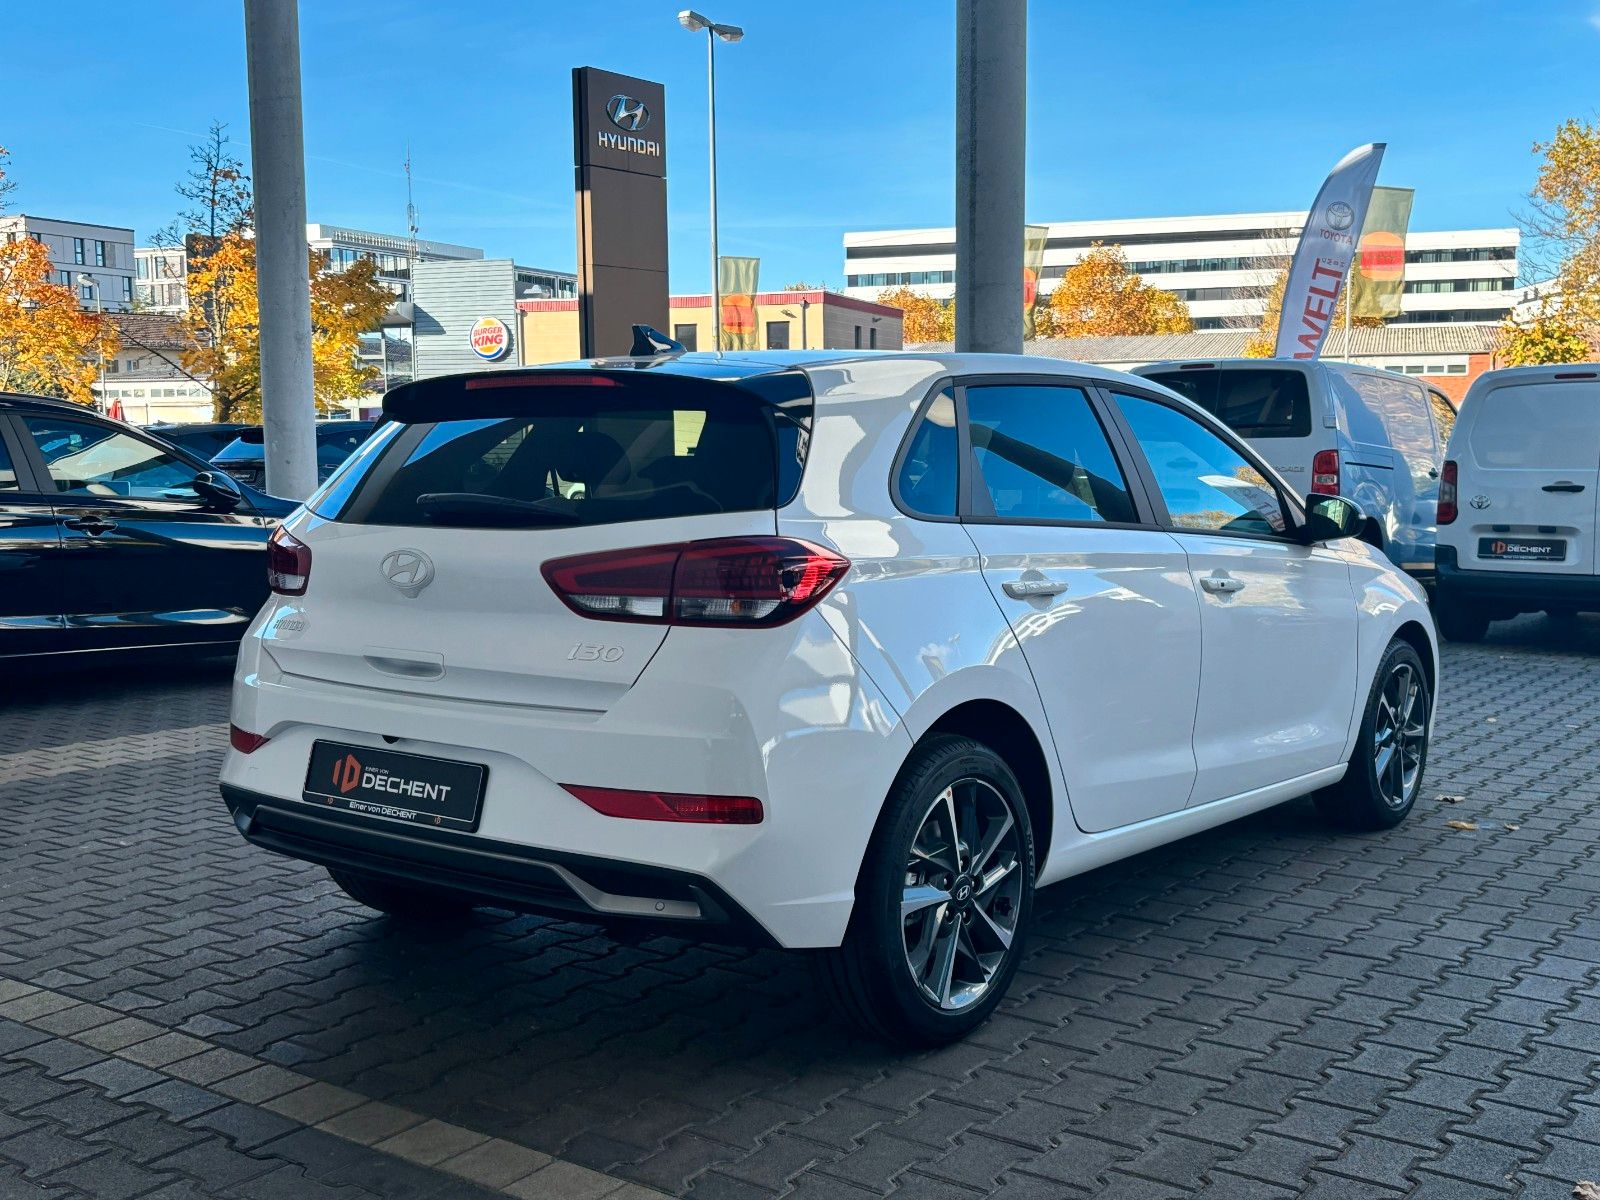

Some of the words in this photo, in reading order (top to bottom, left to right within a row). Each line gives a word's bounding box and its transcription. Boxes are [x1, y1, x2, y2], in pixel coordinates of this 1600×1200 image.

[598, 131, 660, 157] HYUNDAI
[1320, 227, 1353, 246] TOYOTA
[473, 326, 503, 337] BURGER
[473, 334, 503, 348] KING
[1507, 545, 1553, 554] DECHENT
[362, 772, 452, 802] DECHENT
[349, 800, 368, 810] Einer
[368, 805, 381, 813] von
[381, 807, 418, 820] DECHENT
